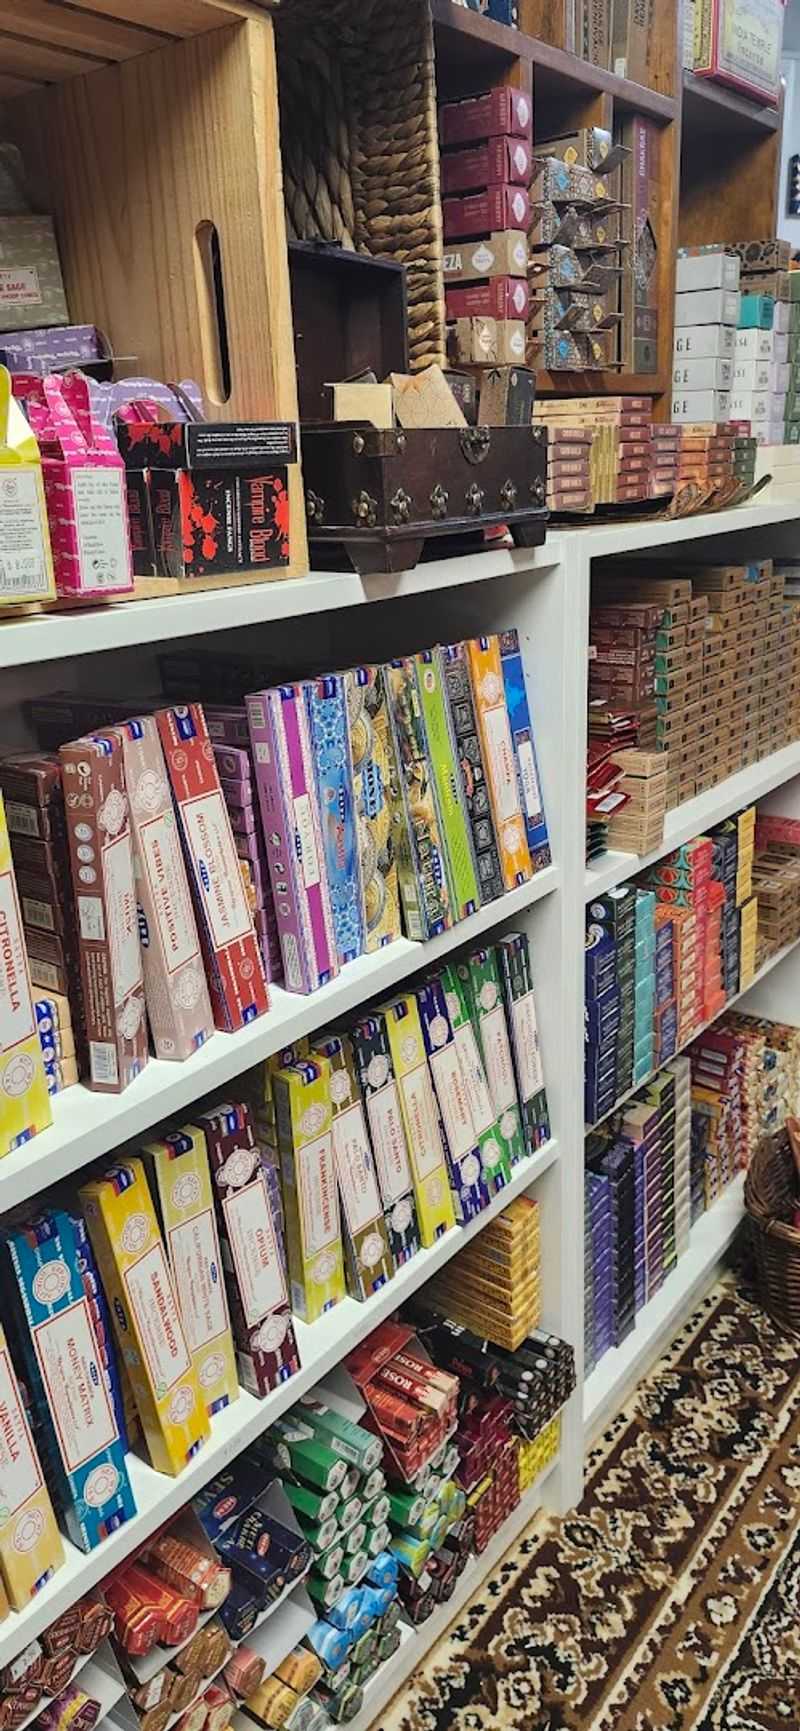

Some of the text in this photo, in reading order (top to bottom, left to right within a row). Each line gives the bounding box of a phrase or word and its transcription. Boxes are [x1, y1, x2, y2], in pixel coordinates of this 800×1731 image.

[245, 475, 274, 562] Vampire Blood
[196, 812, 216, 876] BLOSSOM
[151, 839, 179, 953] POSITIVE VIBES
[214, 881, 230, 928] JASMINE
[0, 911, 21, 1013] CITRONELLA
[387, 1109, 402, 1173] PALO SANTO
[319, 1148, 331, 1233] FRANKINCENSE
[255, 1228, 270, 1268] OPIUM
[150, 1271, 178, 1359] SANDALWOOD
[67, 1337, 83, 1380] MONEY
[79, 1381, 95, 1428] MATRIX
[380, 1368, 414, 1391] ROSE
